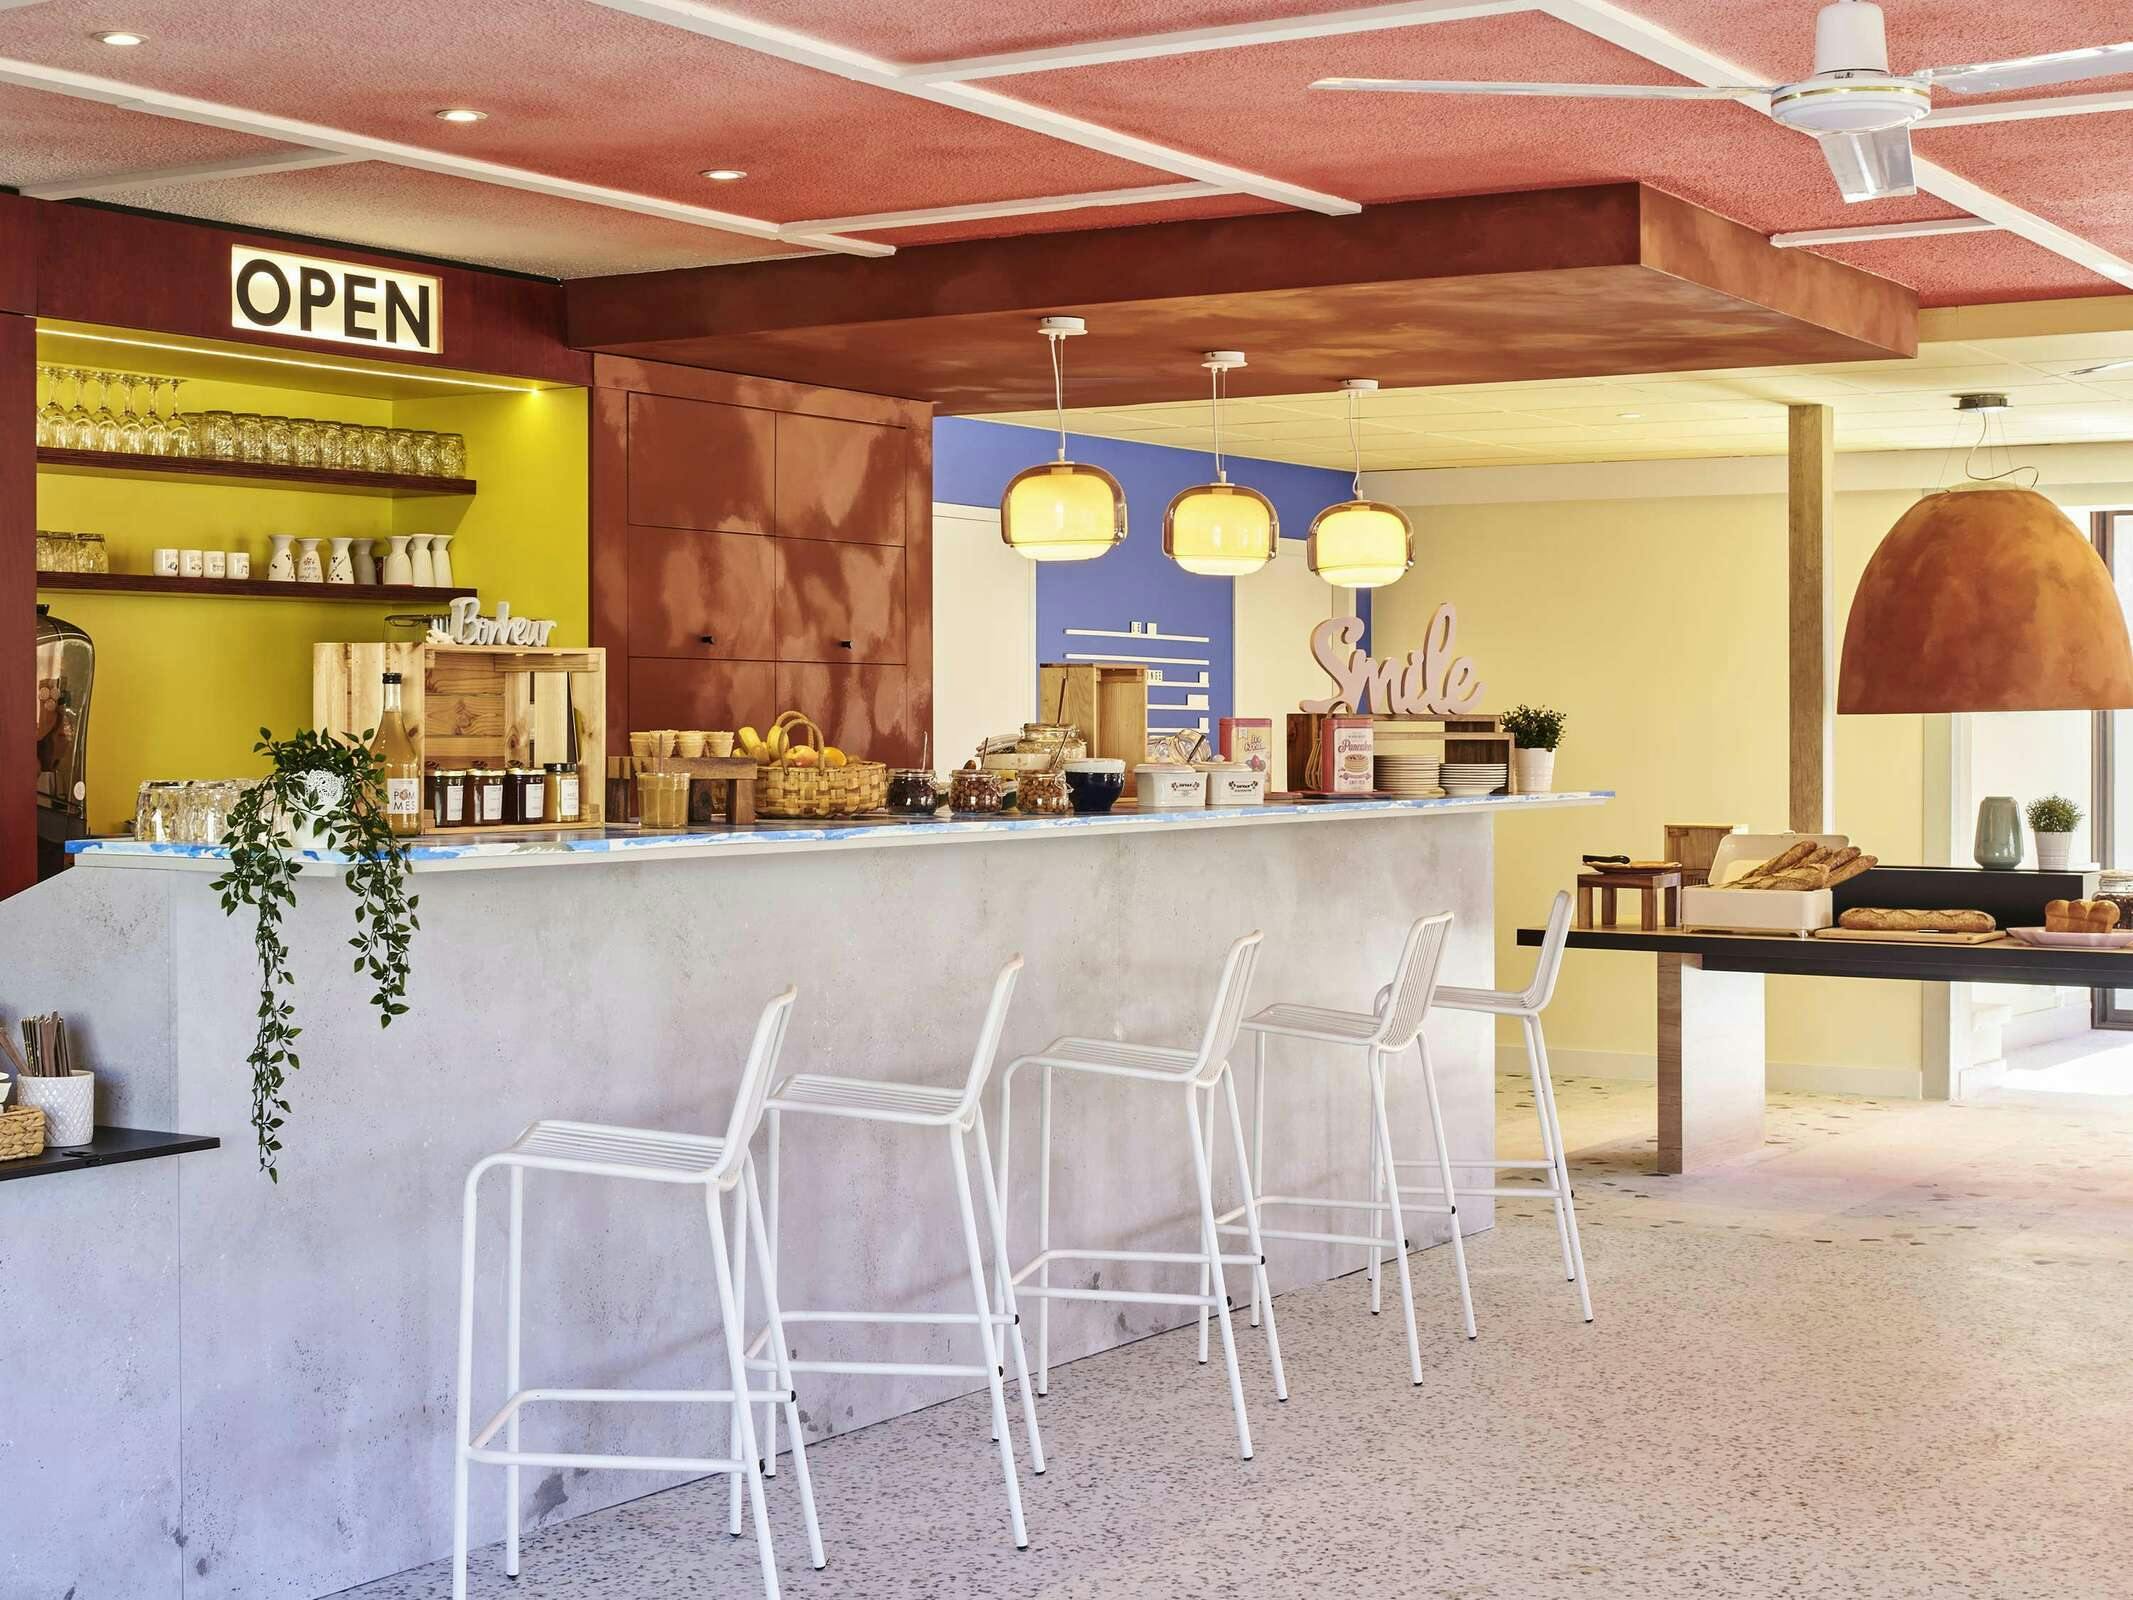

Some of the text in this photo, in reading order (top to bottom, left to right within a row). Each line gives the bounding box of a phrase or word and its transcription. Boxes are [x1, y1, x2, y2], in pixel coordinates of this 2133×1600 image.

[236, 258, 430, 348] OPEN
[449, 596, 557, 647] Bonheur
[1298, 600, 1486, 714] Smile
